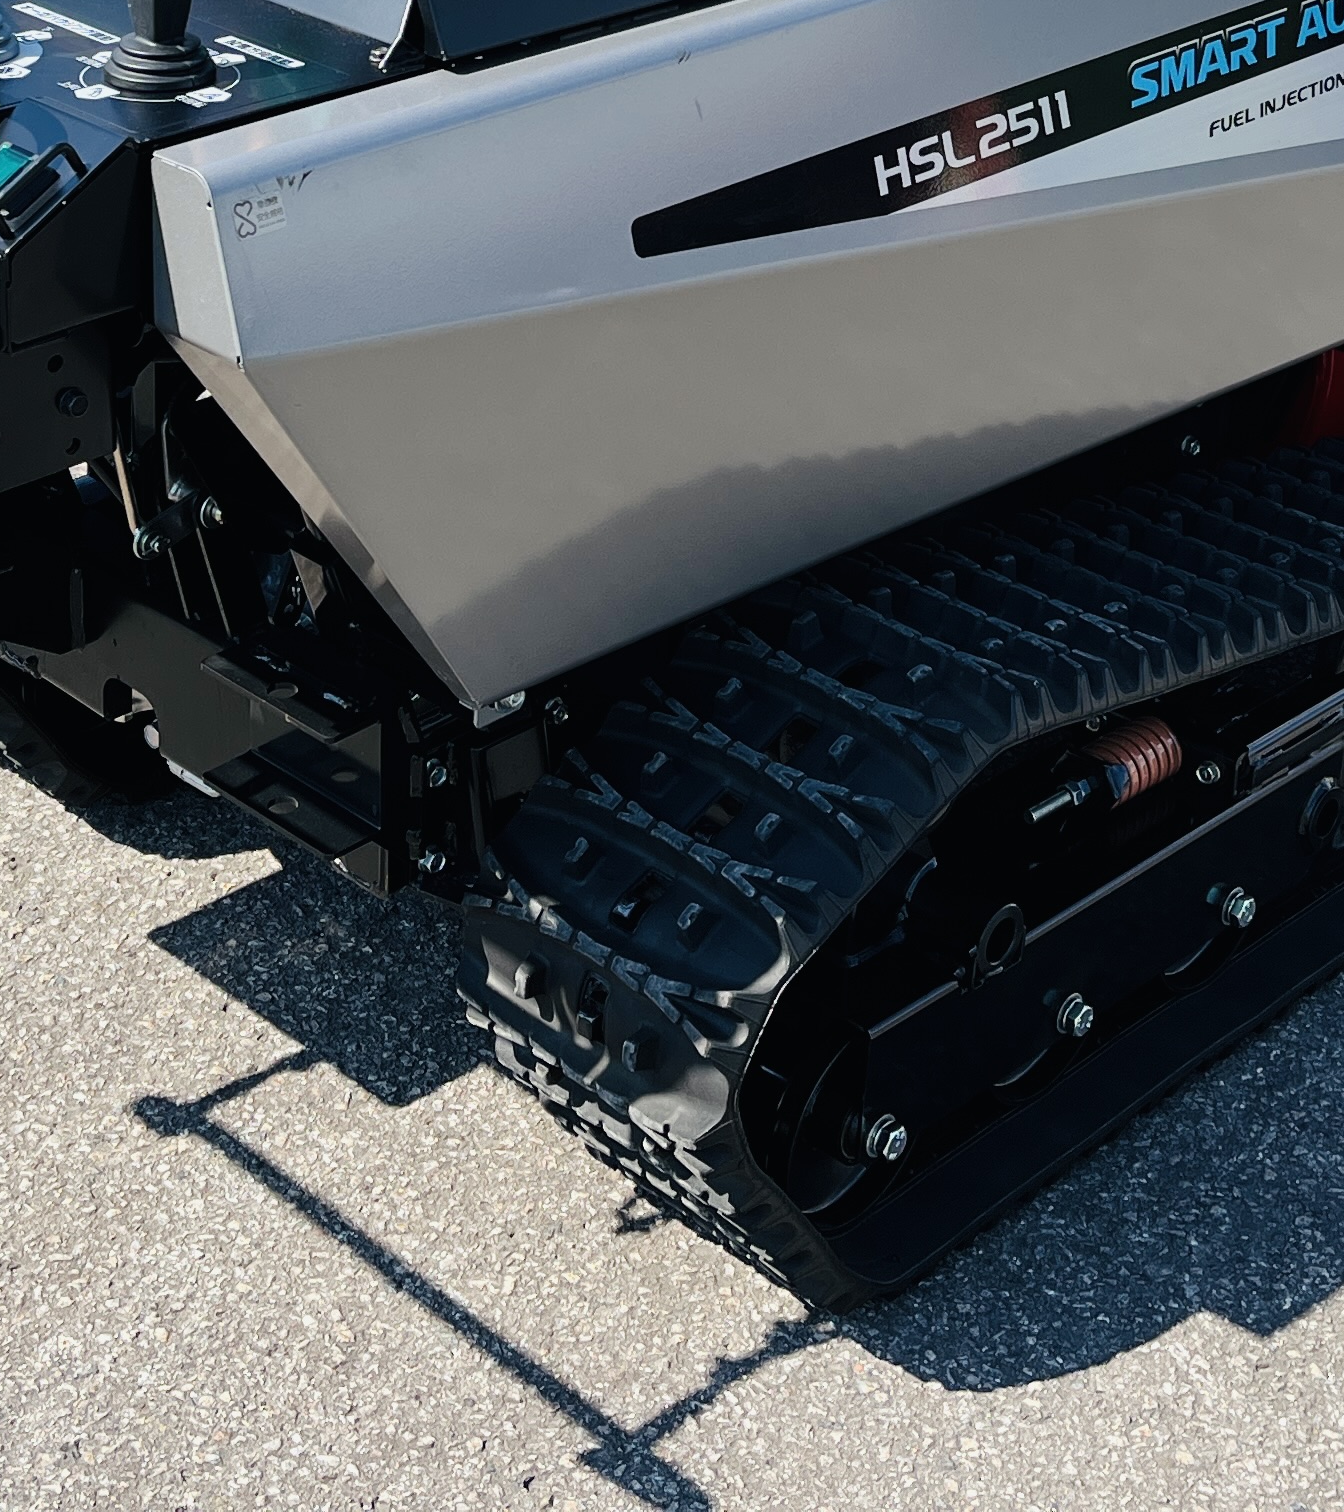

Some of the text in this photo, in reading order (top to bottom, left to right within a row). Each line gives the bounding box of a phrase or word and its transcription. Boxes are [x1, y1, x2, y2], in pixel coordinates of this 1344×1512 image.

[1128, 16, 1289, 110] SMART
[873, 90, 1073, 199] HSL2511
[1208, 105, 1256, 139] FUEL
